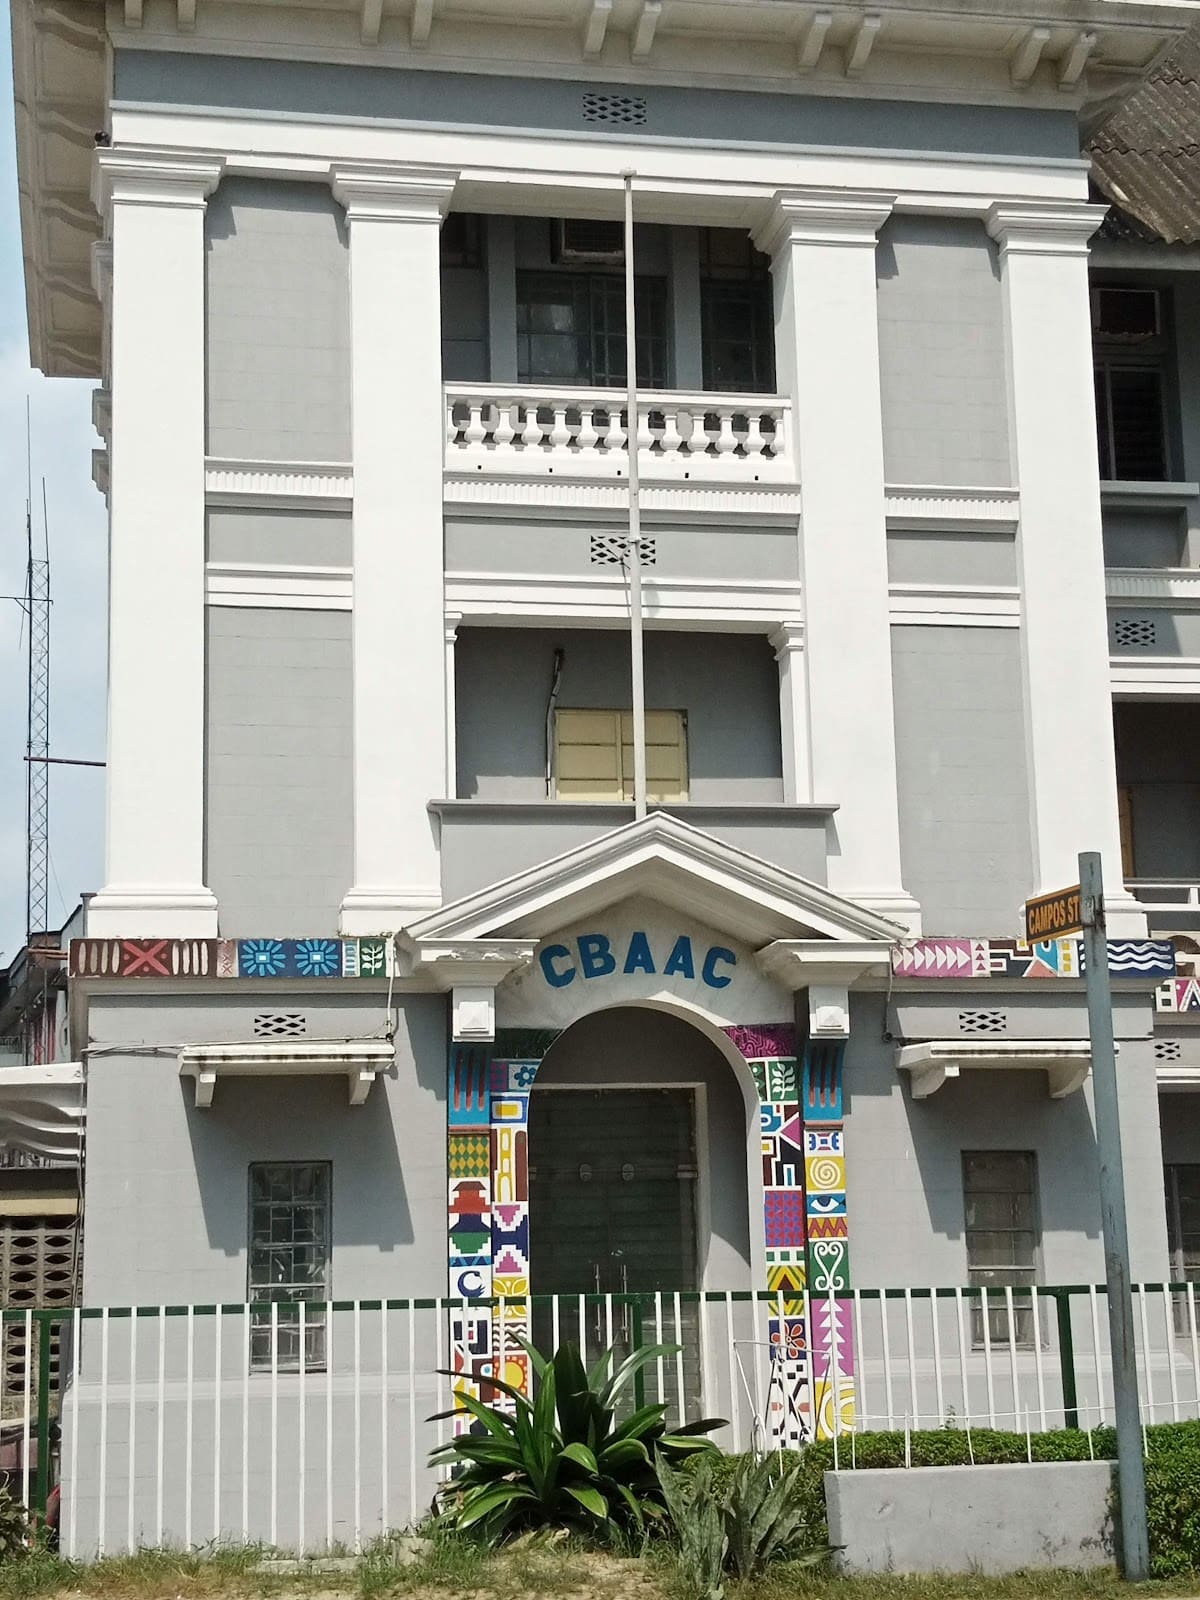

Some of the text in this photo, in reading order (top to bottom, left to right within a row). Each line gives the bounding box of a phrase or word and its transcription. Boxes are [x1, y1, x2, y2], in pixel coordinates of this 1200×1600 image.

[1029, 895, 1079, 935] CAMPOS ST
[539, 931, 737, 989] CBAAC
